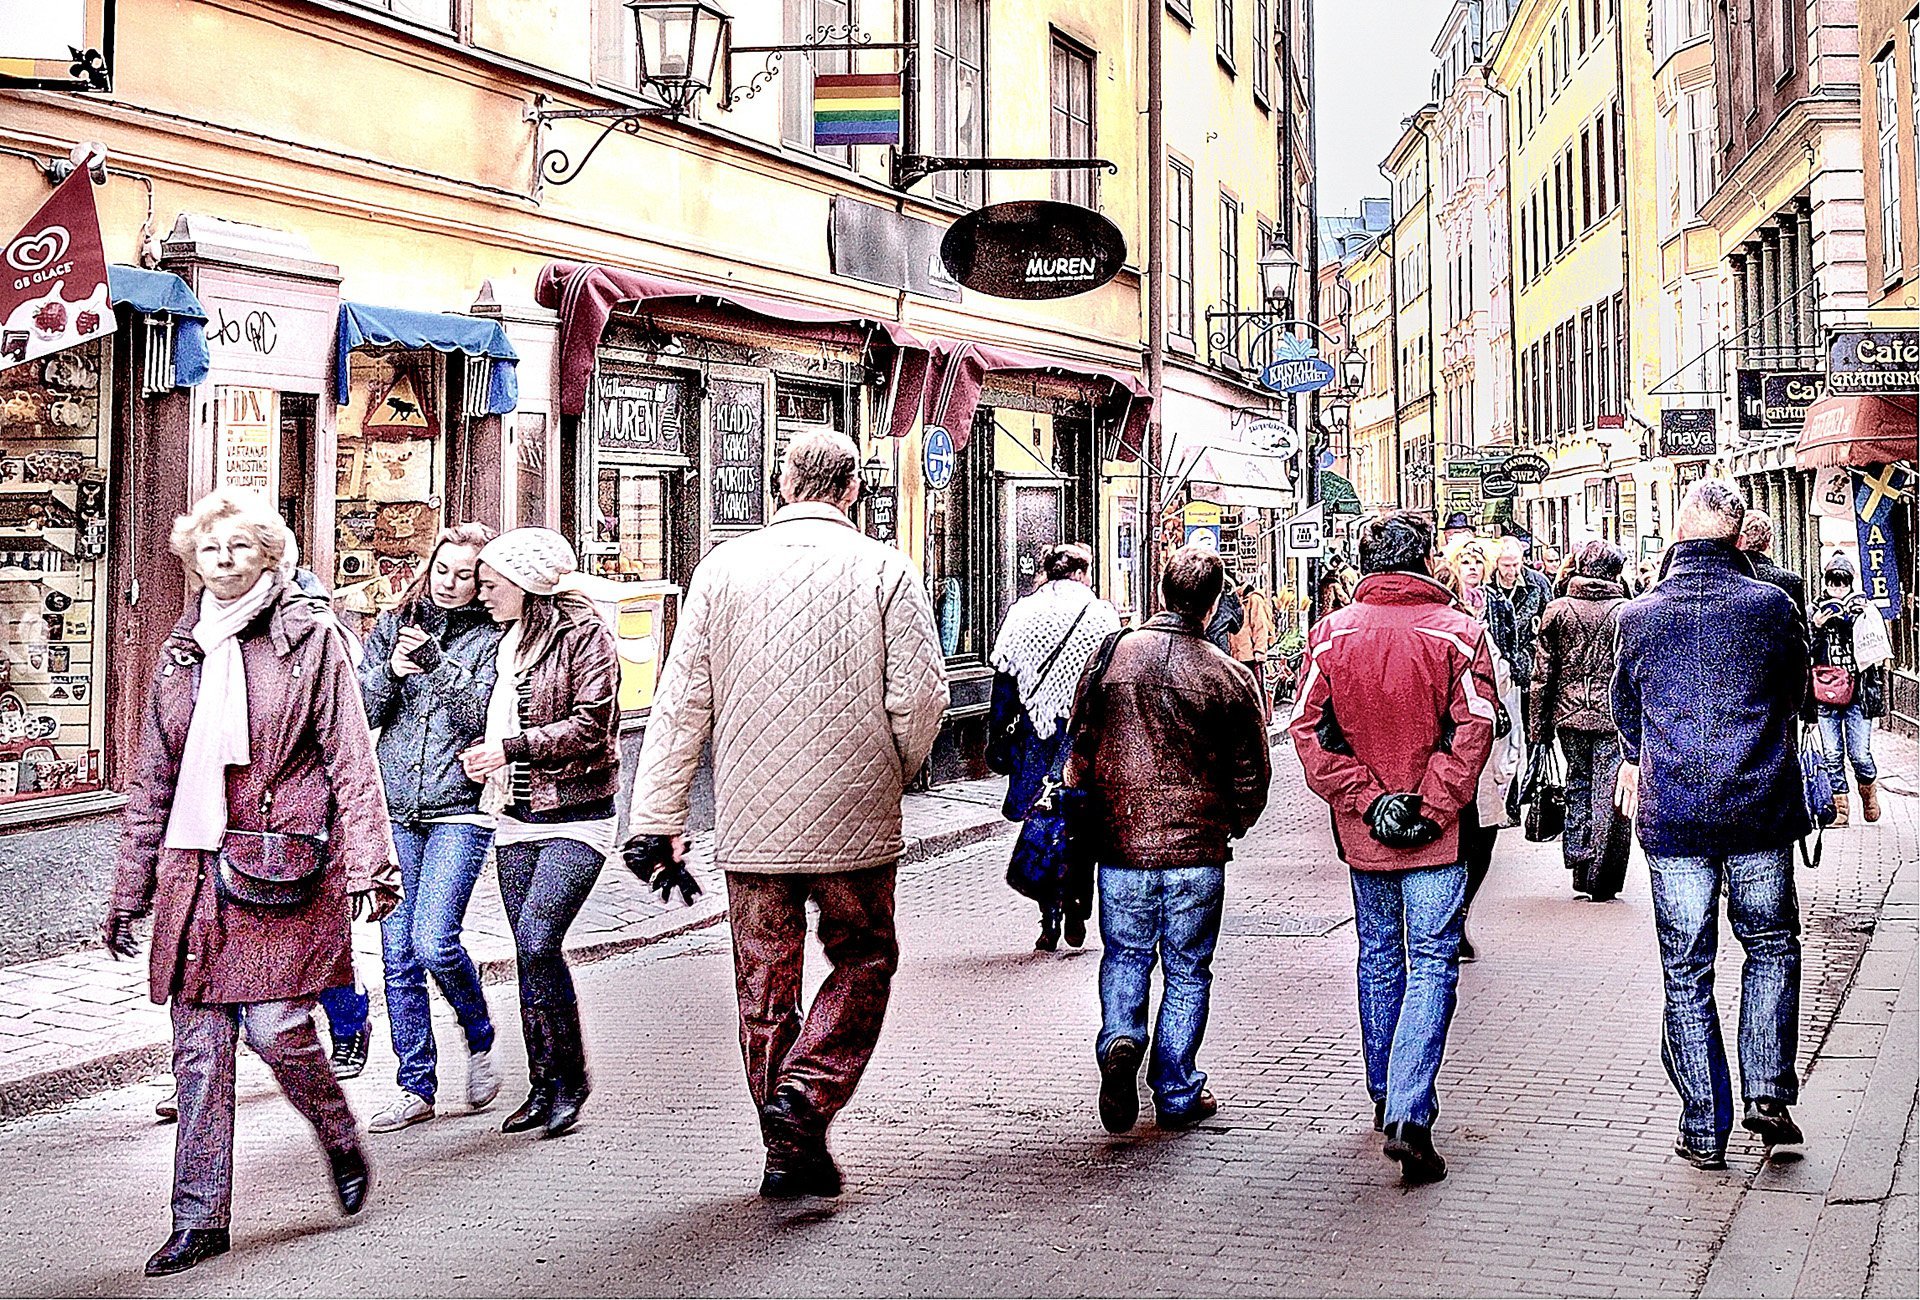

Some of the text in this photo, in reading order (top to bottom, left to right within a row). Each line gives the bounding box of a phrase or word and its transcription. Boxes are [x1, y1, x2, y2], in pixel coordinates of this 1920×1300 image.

[33, 263, 72, 283] GLACE
[1025, 257, 1096, 276] MUREN
[1857, 339, 1918, 364] Café
[1268, 360, 1317, 385] KRISTALL
[598, 399, 658, 443] MUREN
[722, 433, 749, 461] KAKA
[722, 492, 750, 521] KAKA
